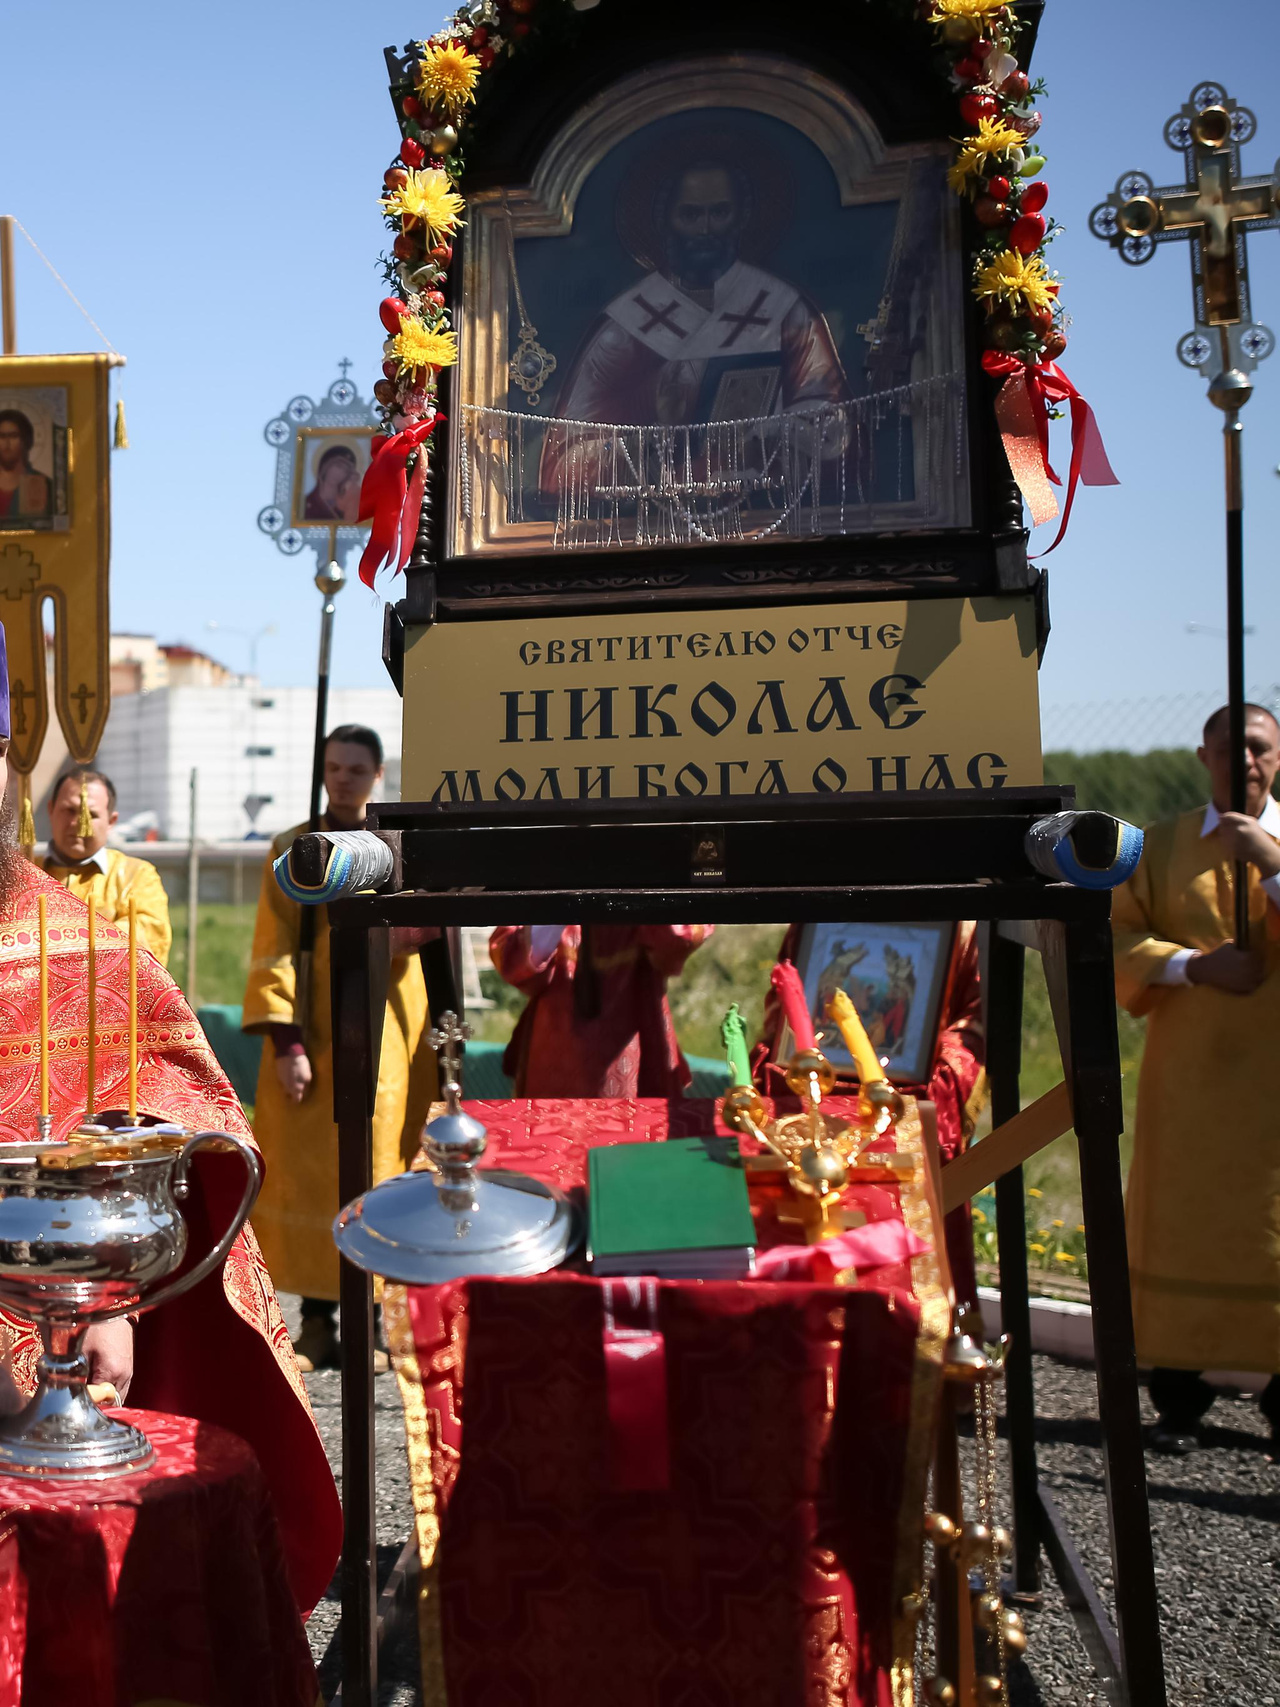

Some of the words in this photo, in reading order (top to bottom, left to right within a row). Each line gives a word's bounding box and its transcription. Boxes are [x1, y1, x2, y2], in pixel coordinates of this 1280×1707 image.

[431, 765, 615, 802] МОЛИ
[633, 759, 790, 797] БОГА
[812, 756, 848, 793] О
[866, 752, 1008, 791] НАС
